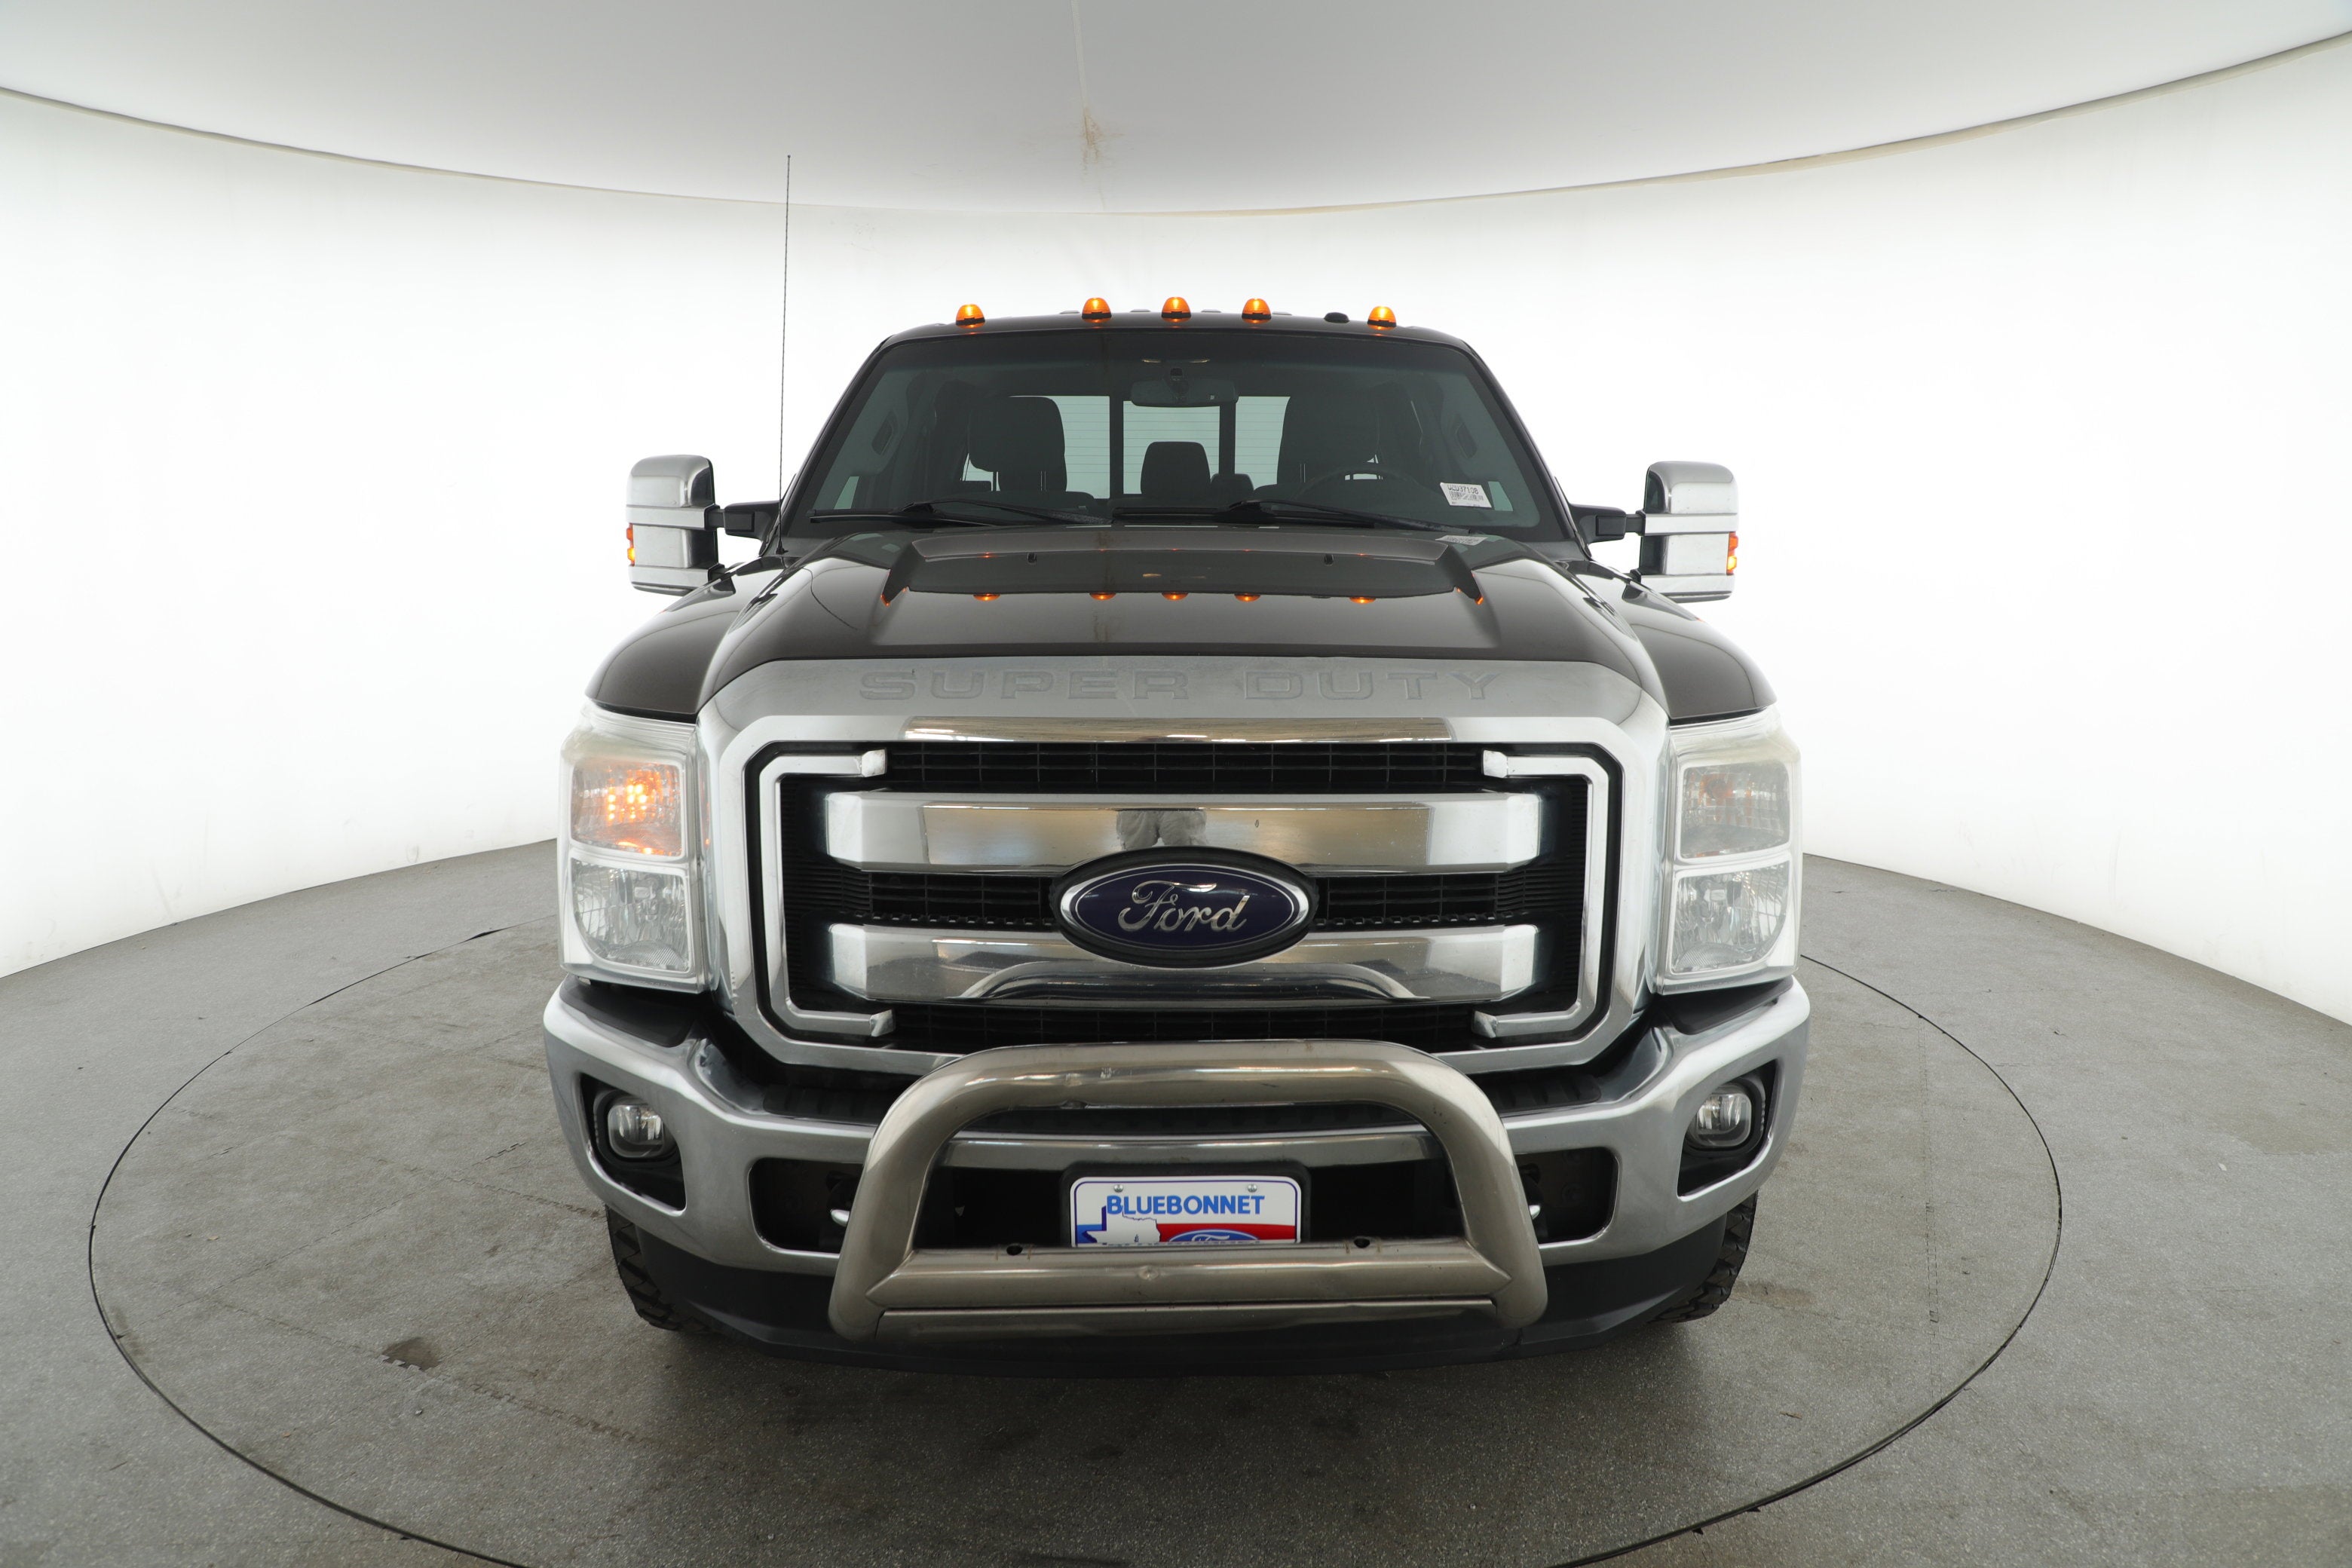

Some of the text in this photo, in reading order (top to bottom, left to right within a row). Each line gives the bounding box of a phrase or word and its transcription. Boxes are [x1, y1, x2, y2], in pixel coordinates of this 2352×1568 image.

[859, 669, 1502, 700] SUPER DUTY
[1117, 880, 1250, 932] Ford
[1106, 1195, 1265, 1215] BLUEBONNET
